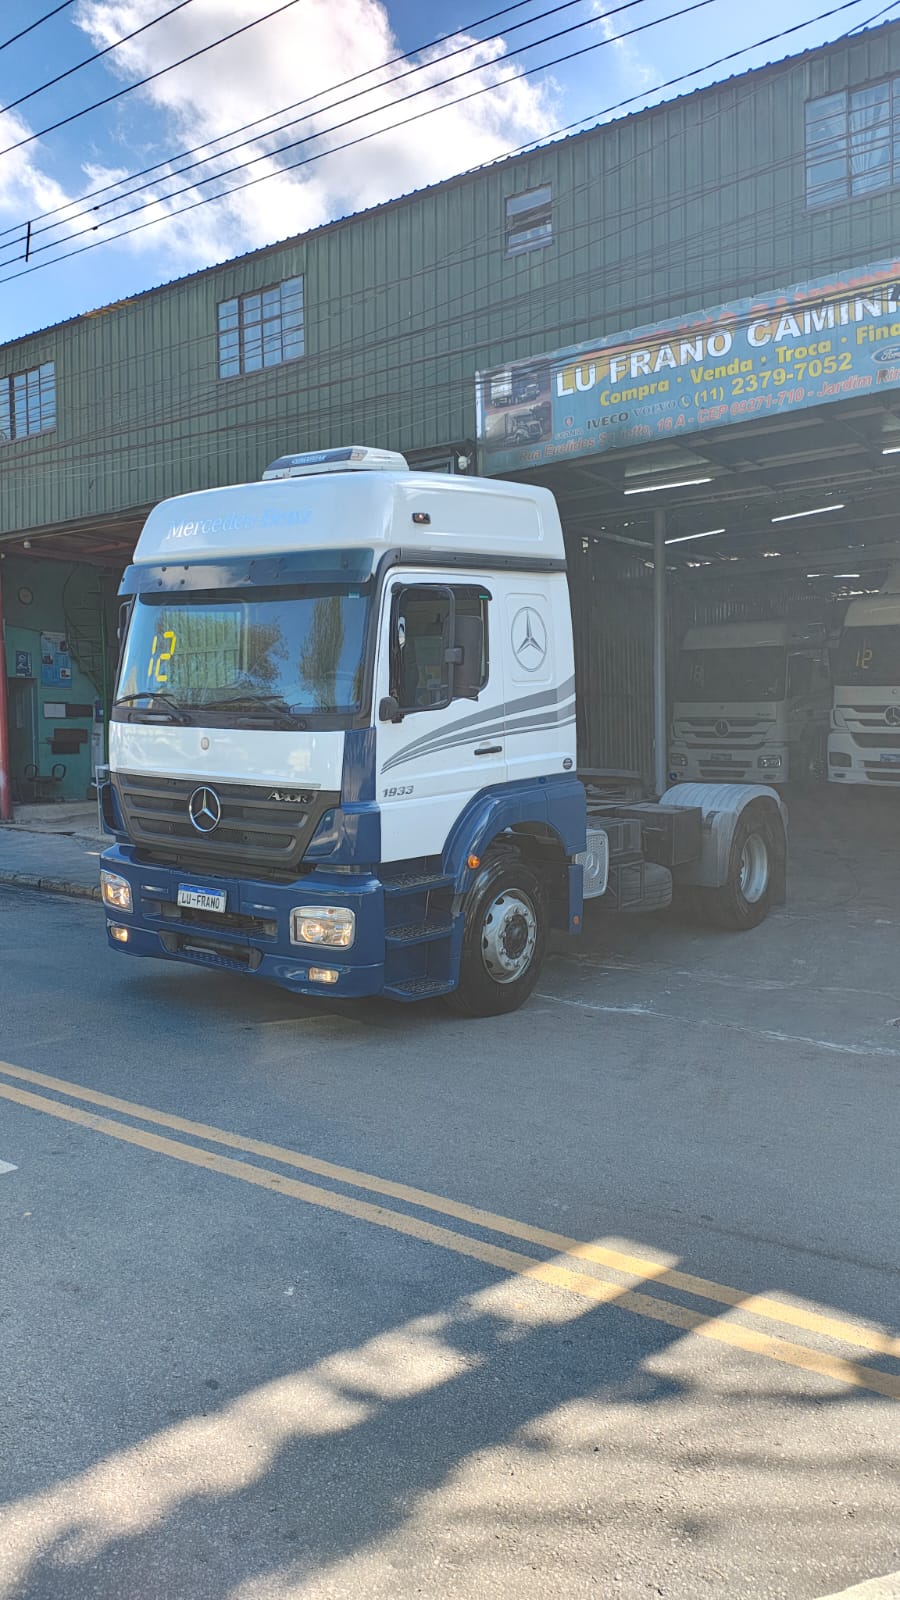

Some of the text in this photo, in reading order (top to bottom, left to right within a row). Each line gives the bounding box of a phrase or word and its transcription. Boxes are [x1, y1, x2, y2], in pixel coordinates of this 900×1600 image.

[556, 363, 597, 397] LU
[609, 328, 733, 385] FRANO
[600, 379, 670, 407] Compra
[690, 358, 753, 384] Venda
[775, 339, 832, 364] Troca
[694, 352, 853, 407] (11) 2379-7052
[520, 449, 541, 462] Rua
[545, 437, 596, 457] Euclides
[674, 413, 686, 428] A
[697, 403, 728, 424] CEP
[817, 374, 872, 398] Jardim
[587, 411, 629, 430] IVECO
[147, 630, 177, 682] 12
[382, 785, 415, 798] 1933
[181, 892, 220, 909] LU-FRANO
